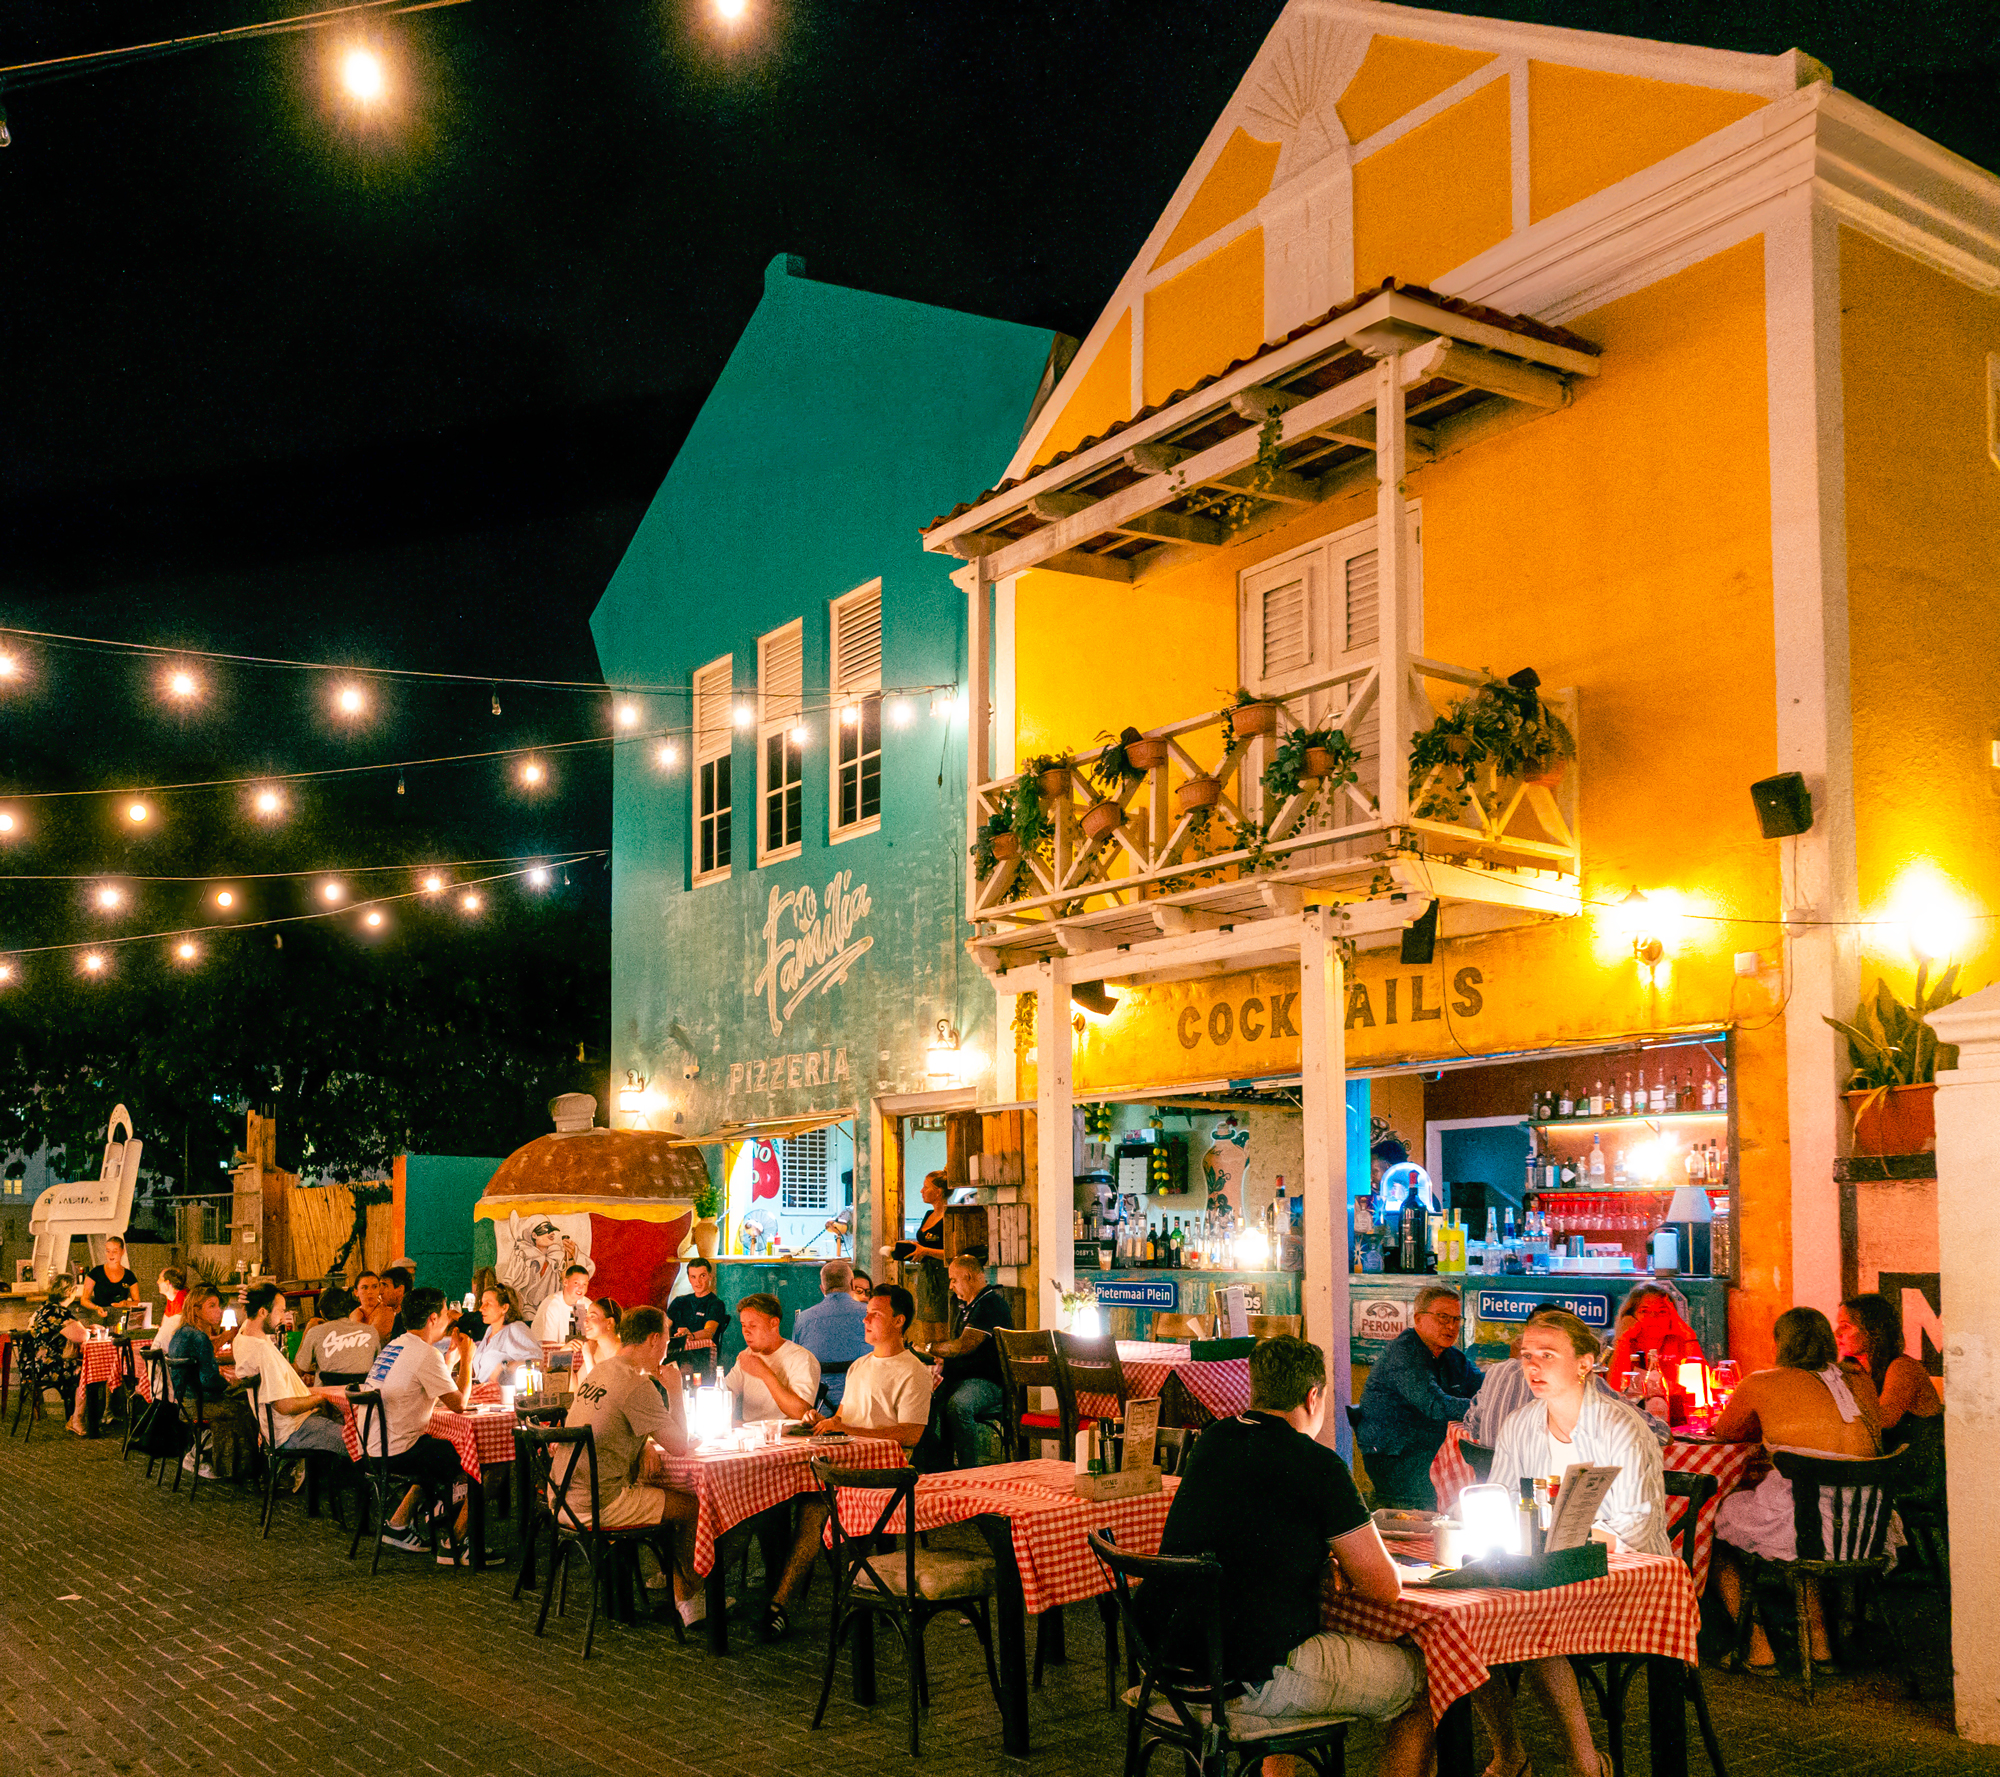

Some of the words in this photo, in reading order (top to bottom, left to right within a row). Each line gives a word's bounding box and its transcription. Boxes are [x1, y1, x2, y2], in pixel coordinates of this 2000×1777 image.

[1177, 966, 1485, 1050] COCKAILS
[729, 1048, 850, 1096] PIZZERIA
[1097, 1286, 1145, 1300] Pietermaai
[1147, 1288, 1170, 1301] Plein
[1361, 1318, 1403, 1332] PERONI
